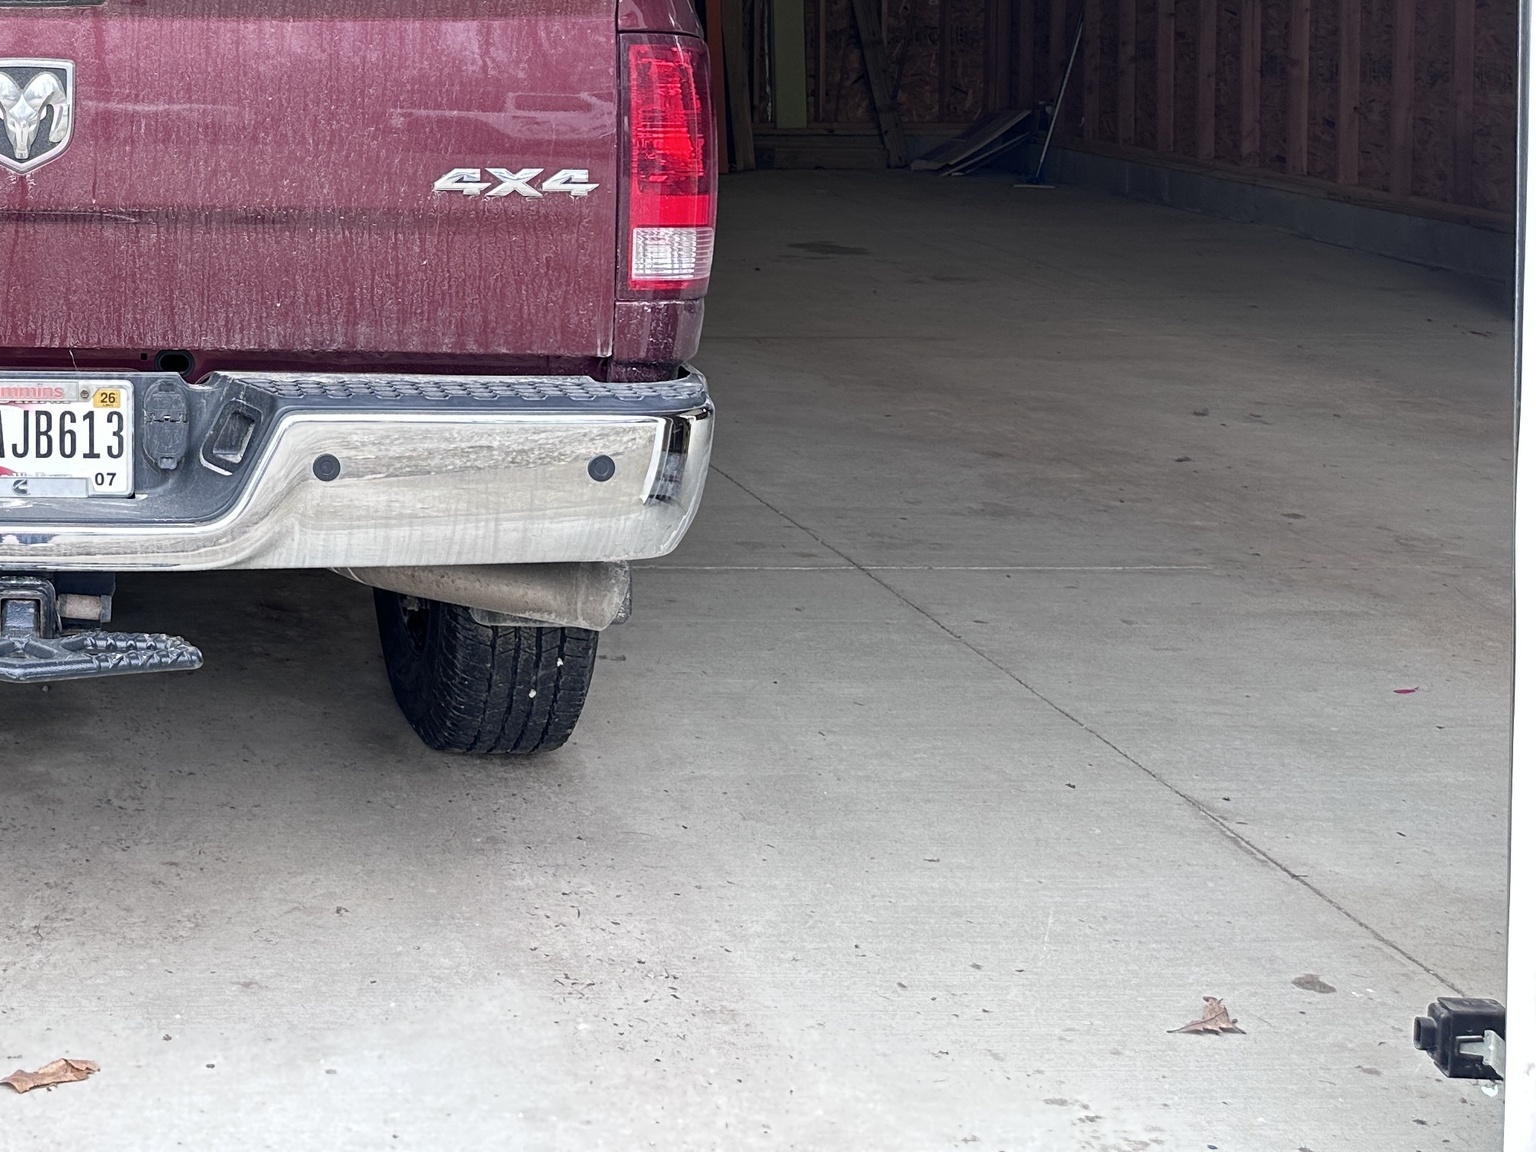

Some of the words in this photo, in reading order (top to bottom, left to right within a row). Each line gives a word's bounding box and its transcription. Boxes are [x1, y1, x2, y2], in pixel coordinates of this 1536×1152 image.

[433, 167, 600, 198] 4X4
[100, 392, 116, 404] 26
[94, 472, 117, 486] 07
